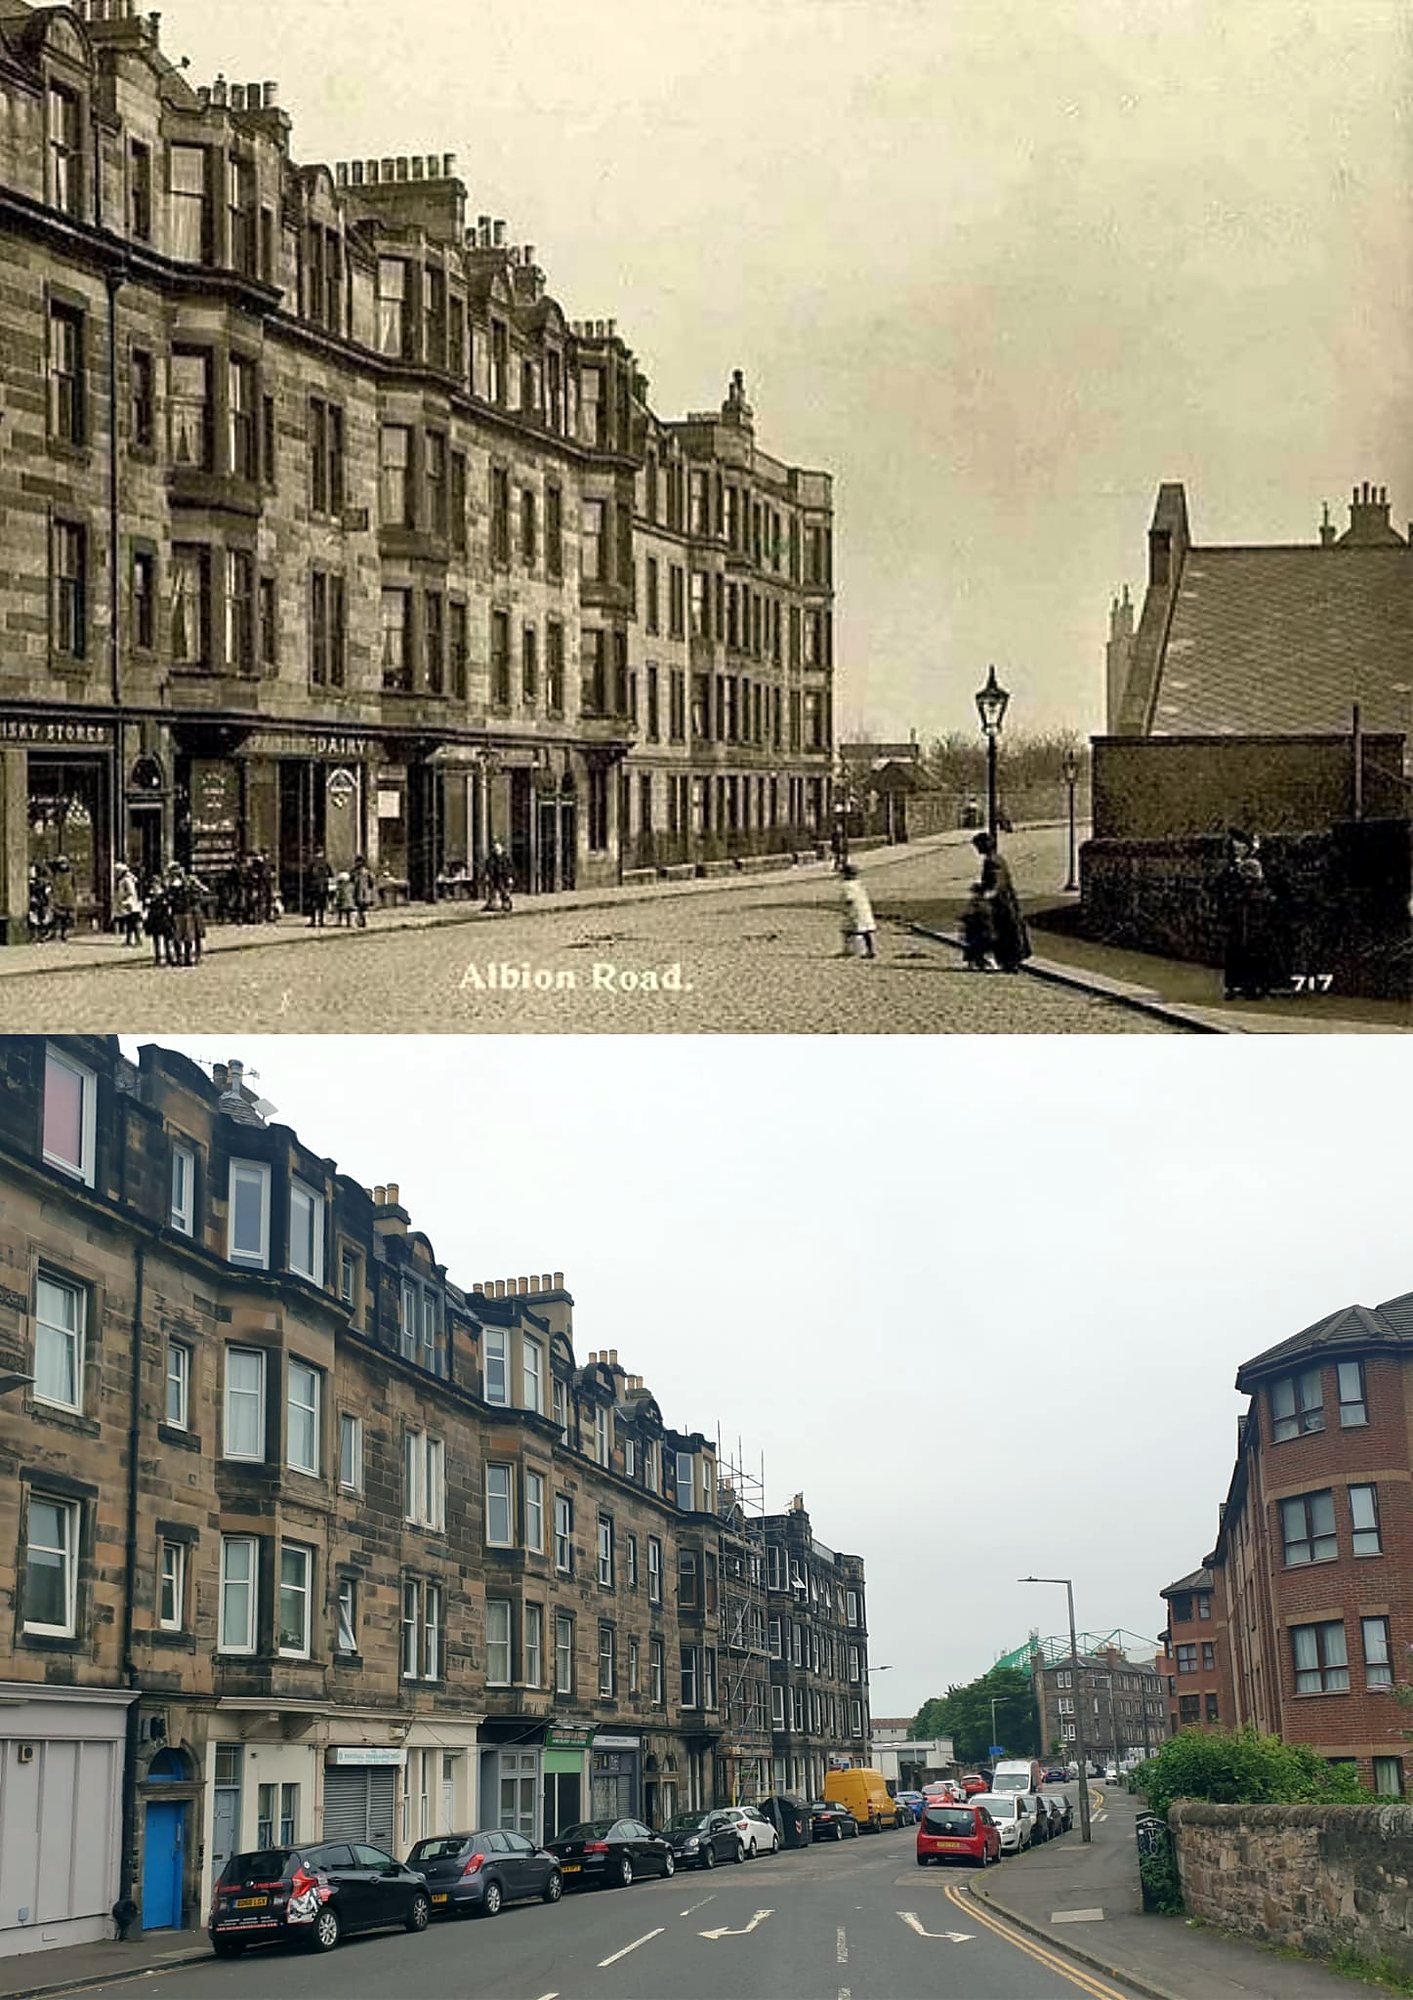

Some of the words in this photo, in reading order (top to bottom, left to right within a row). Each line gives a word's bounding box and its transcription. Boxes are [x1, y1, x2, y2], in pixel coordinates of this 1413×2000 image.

[0, 719, 39, 740] ISKY
[46, 724, 105, 742] STORES
[317, 736, 366, 755] DAIRY
